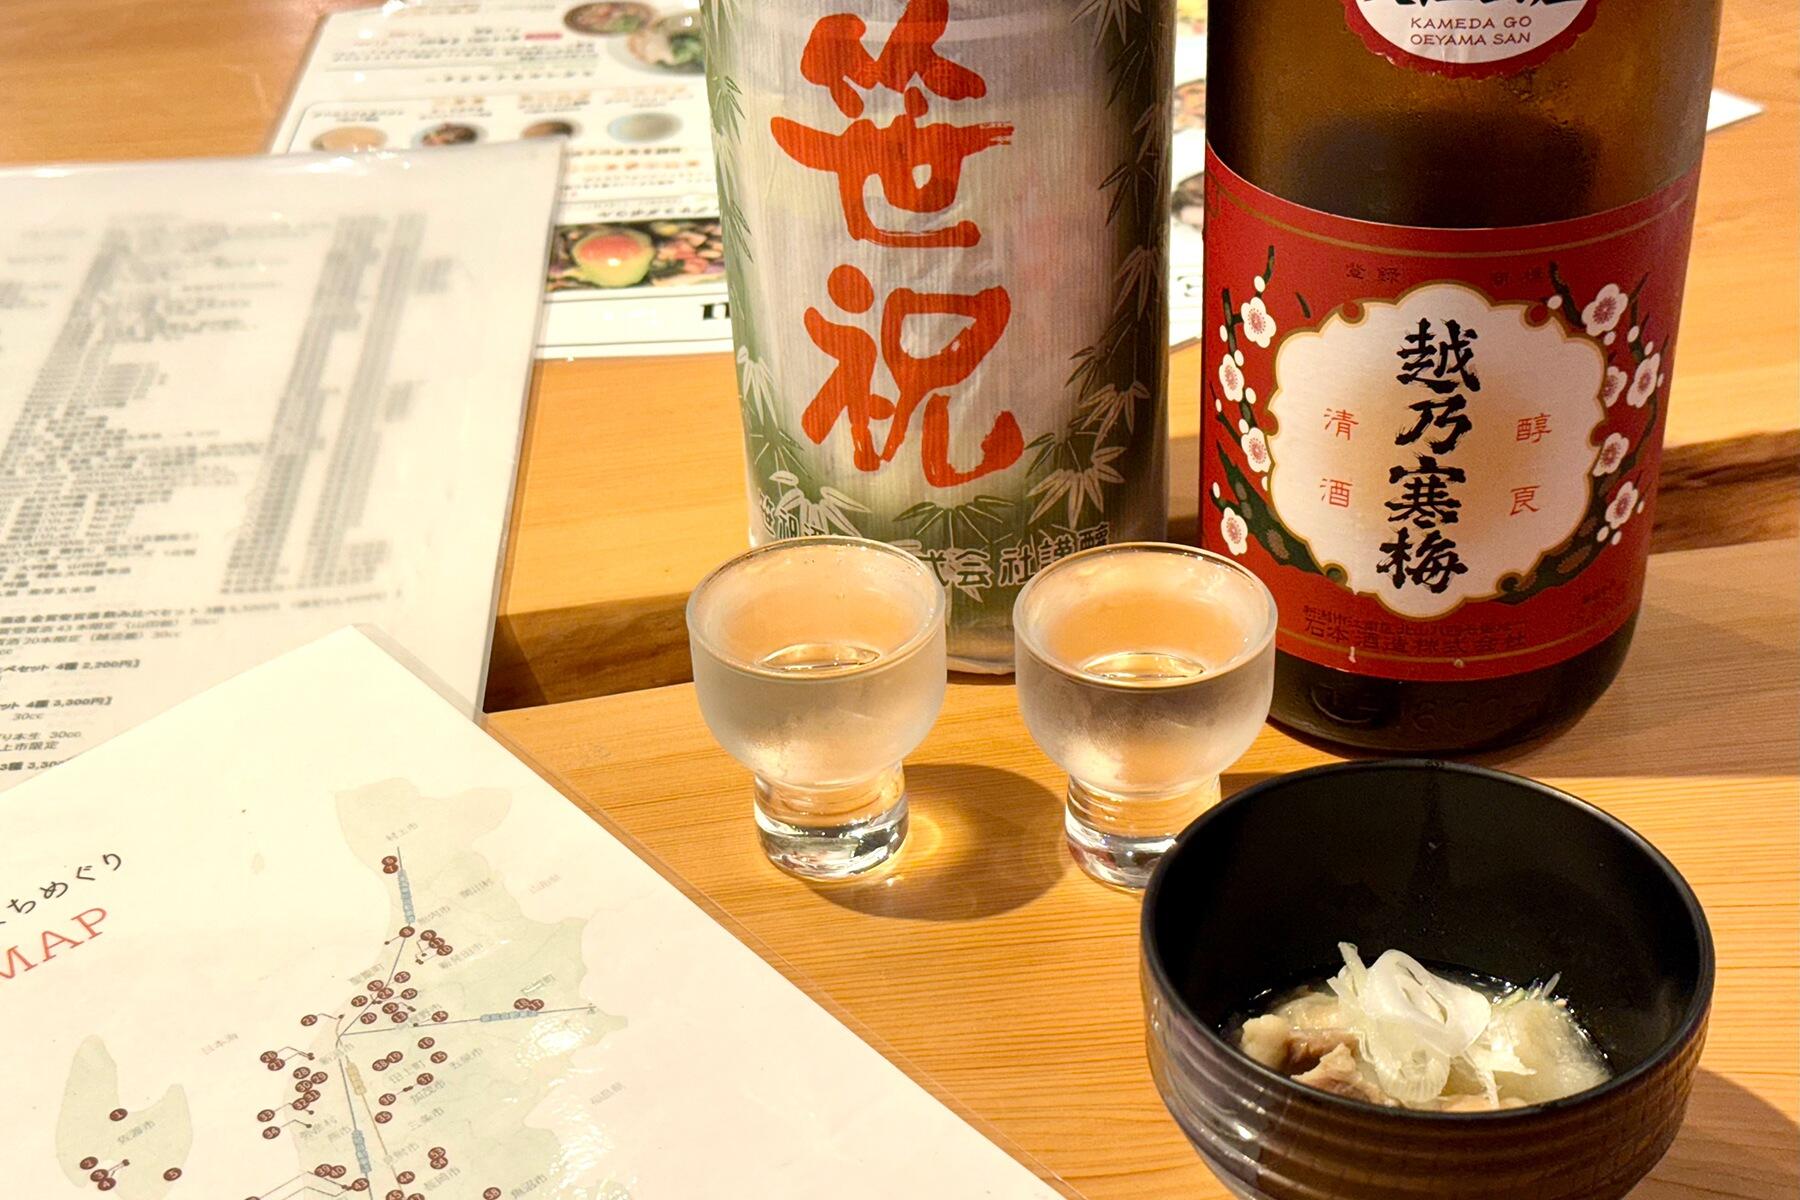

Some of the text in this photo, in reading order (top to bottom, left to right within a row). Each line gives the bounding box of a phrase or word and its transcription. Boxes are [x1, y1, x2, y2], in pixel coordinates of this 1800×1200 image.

[1410, 15, 1532, 30] KAMEDA GO
[1410, 32, 1531, 46] OEYAMA SAN
[1320, 407, 1359, 508] 清酒
[1376, 318, 1480, 593] 越乃寒梅
